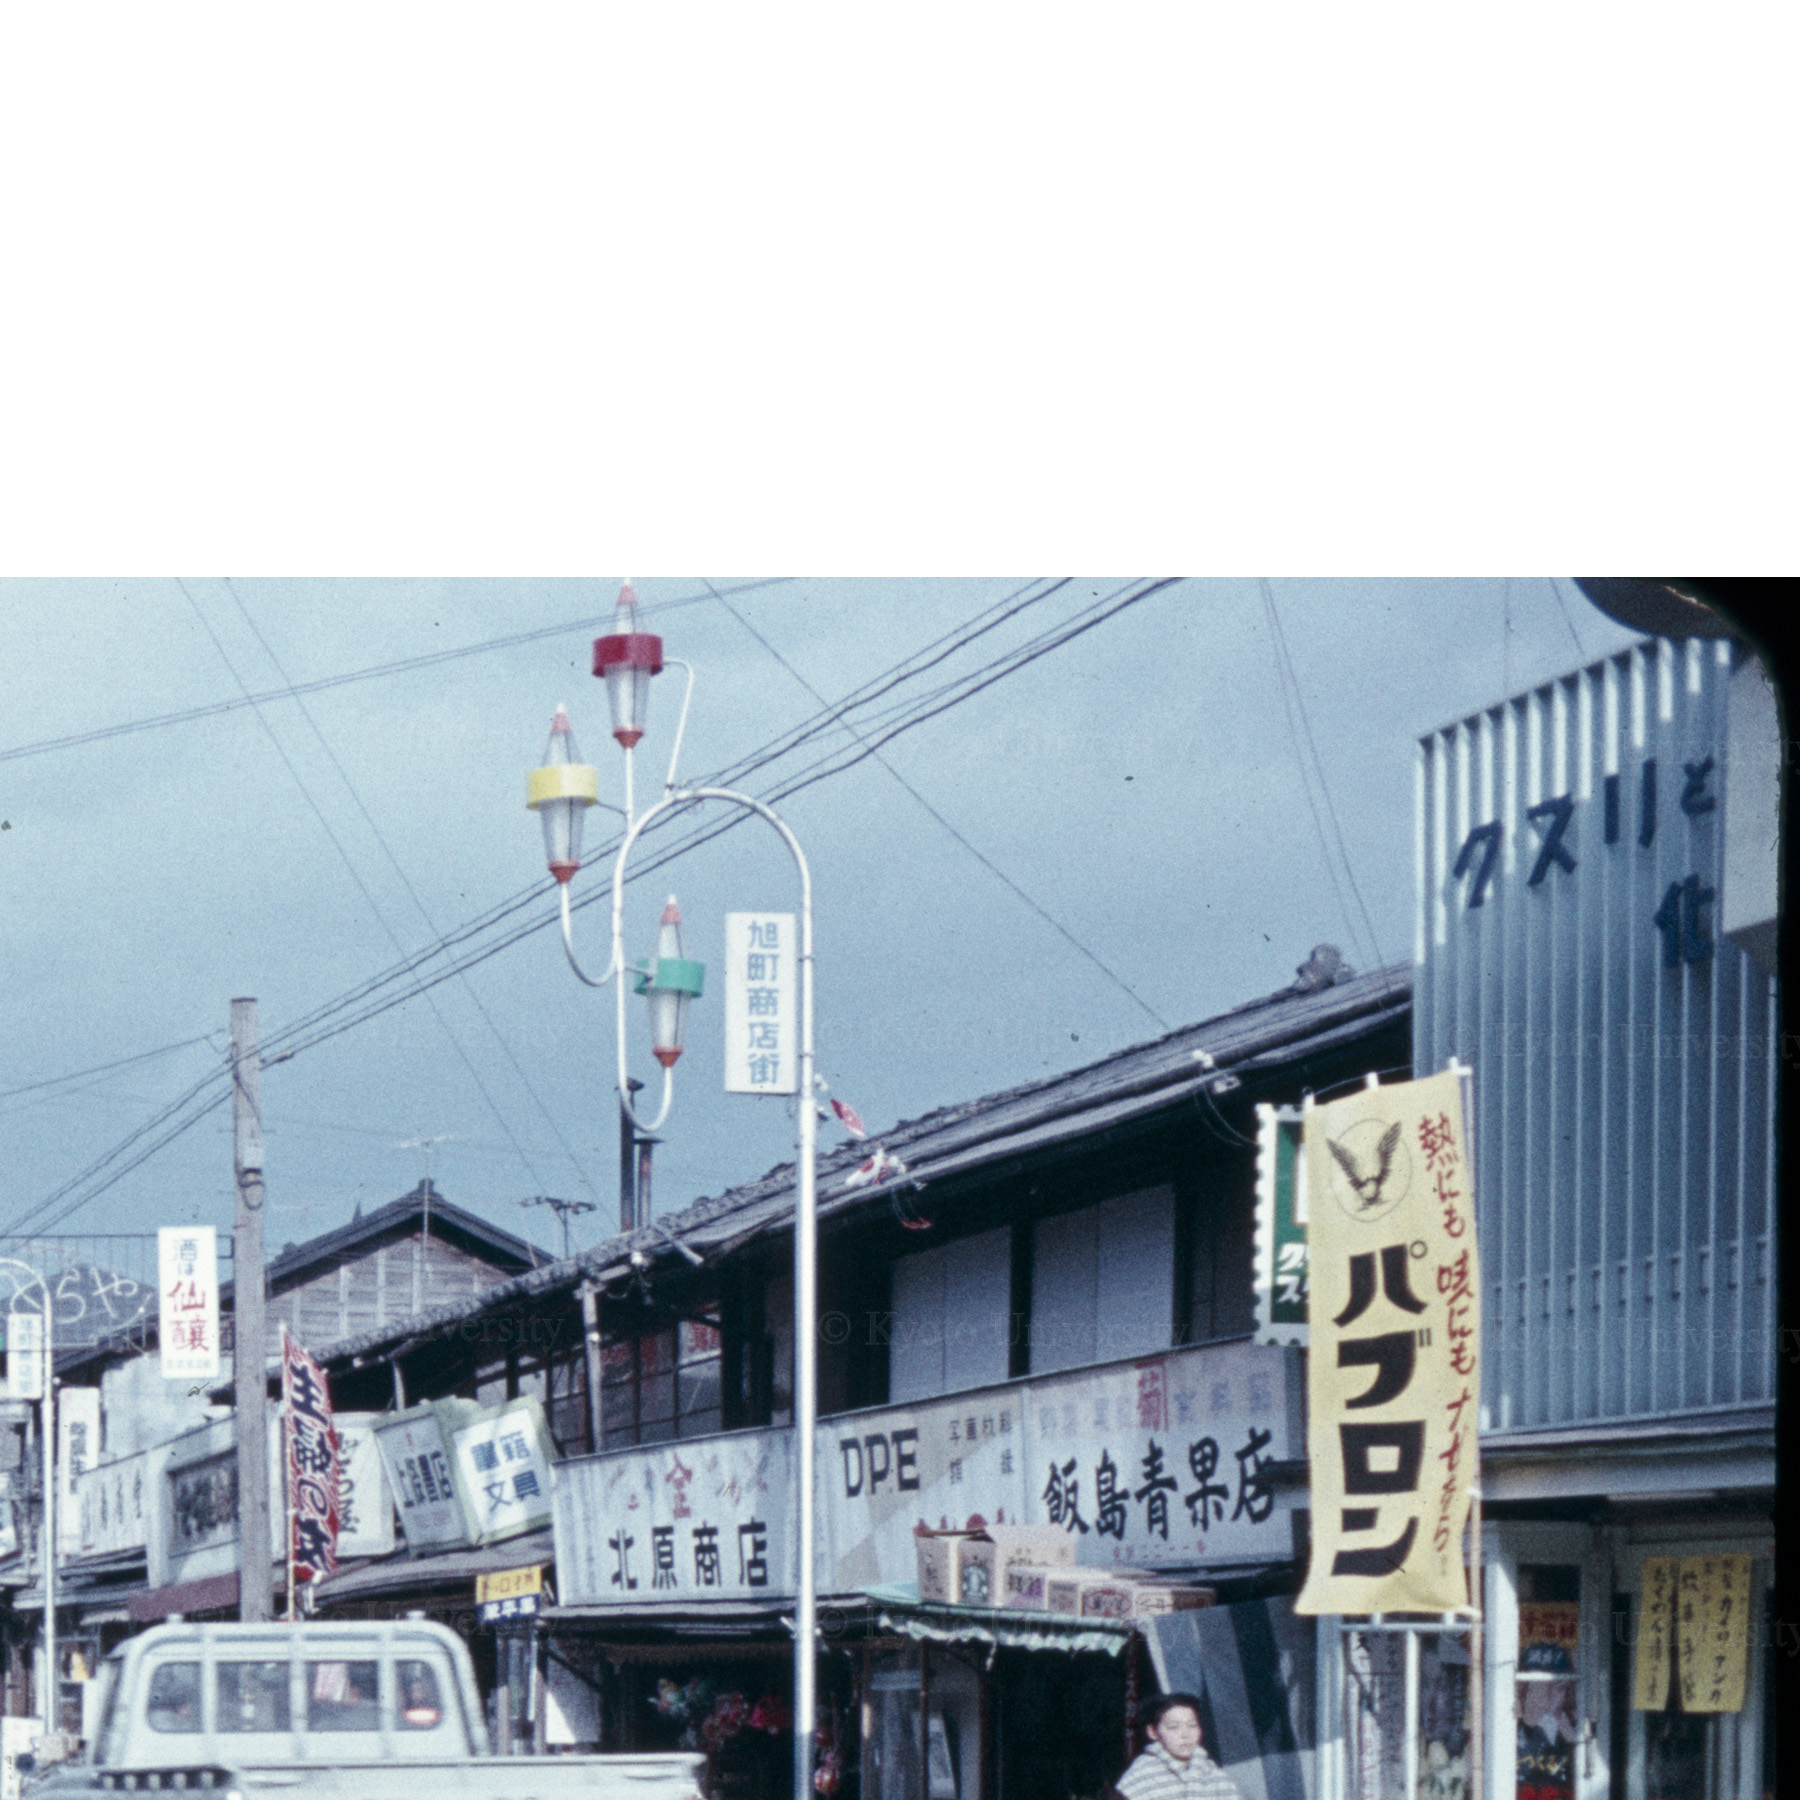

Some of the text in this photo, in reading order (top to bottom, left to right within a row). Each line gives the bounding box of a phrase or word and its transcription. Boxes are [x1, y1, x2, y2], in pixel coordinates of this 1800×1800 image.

[746, 919, 781, 1085] 旭町商店街
[166, 1238, 210, 1353] 酒は仙醸
[1273, 1274, 1309, 1307] ス
[470, 1431, 532, 1474] 書籍
[1330, 1239, 1432, 1579] パブロン
[483, 1470, 541, 1512] 文具
[1042, 1426, 1278, 1542] 飯島青果店
[608, 1516, 769, 1591] 北原商店
